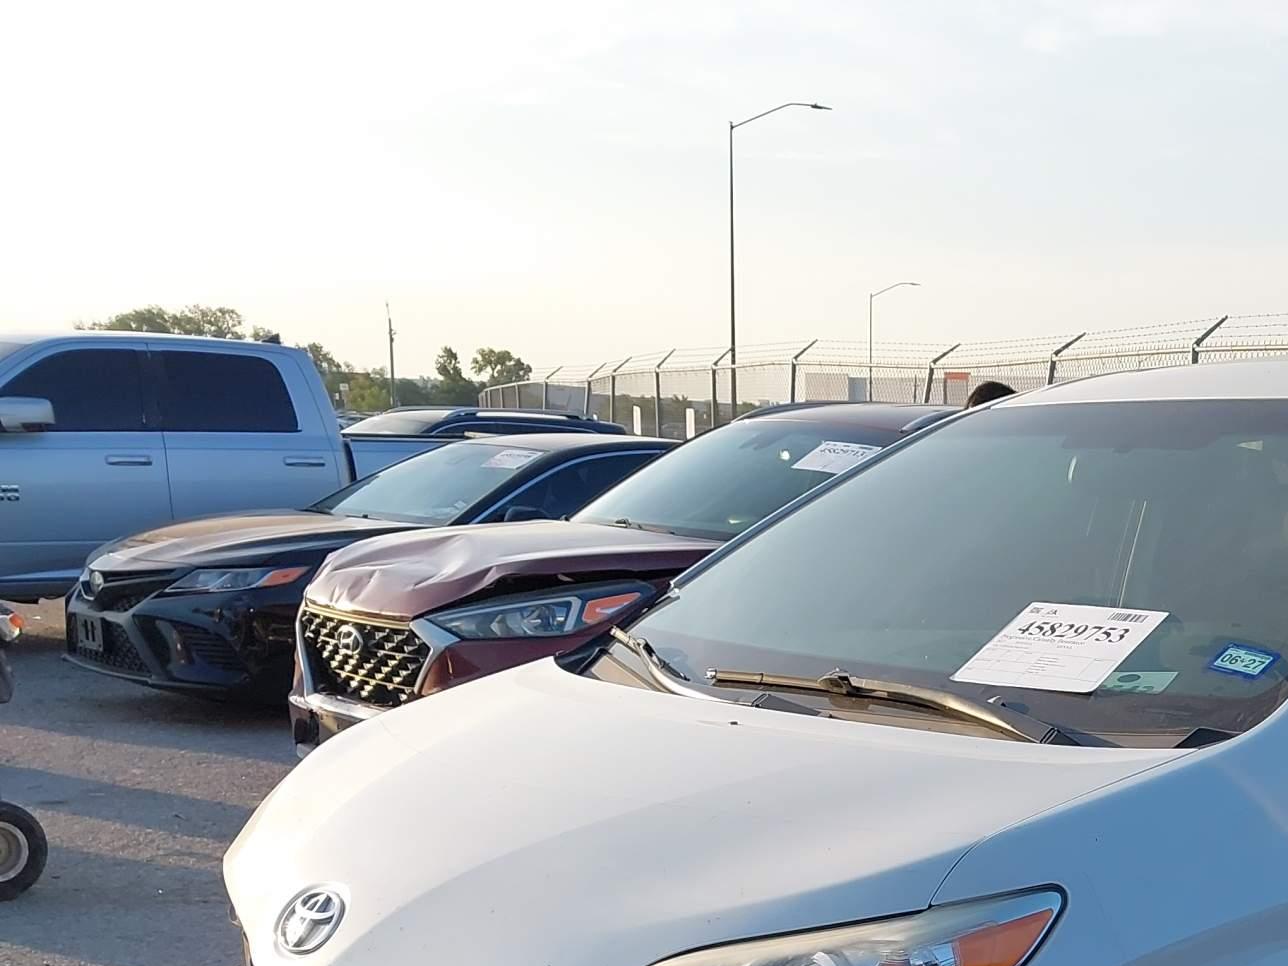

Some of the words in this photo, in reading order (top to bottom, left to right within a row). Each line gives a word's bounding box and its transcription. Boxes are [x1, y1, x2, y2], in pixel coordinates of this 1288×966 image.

[1017, 620, 1131, 643] 45829753
[1220, 653, 1242, 665] 06
[1242, 658, 1267, 670] 27
